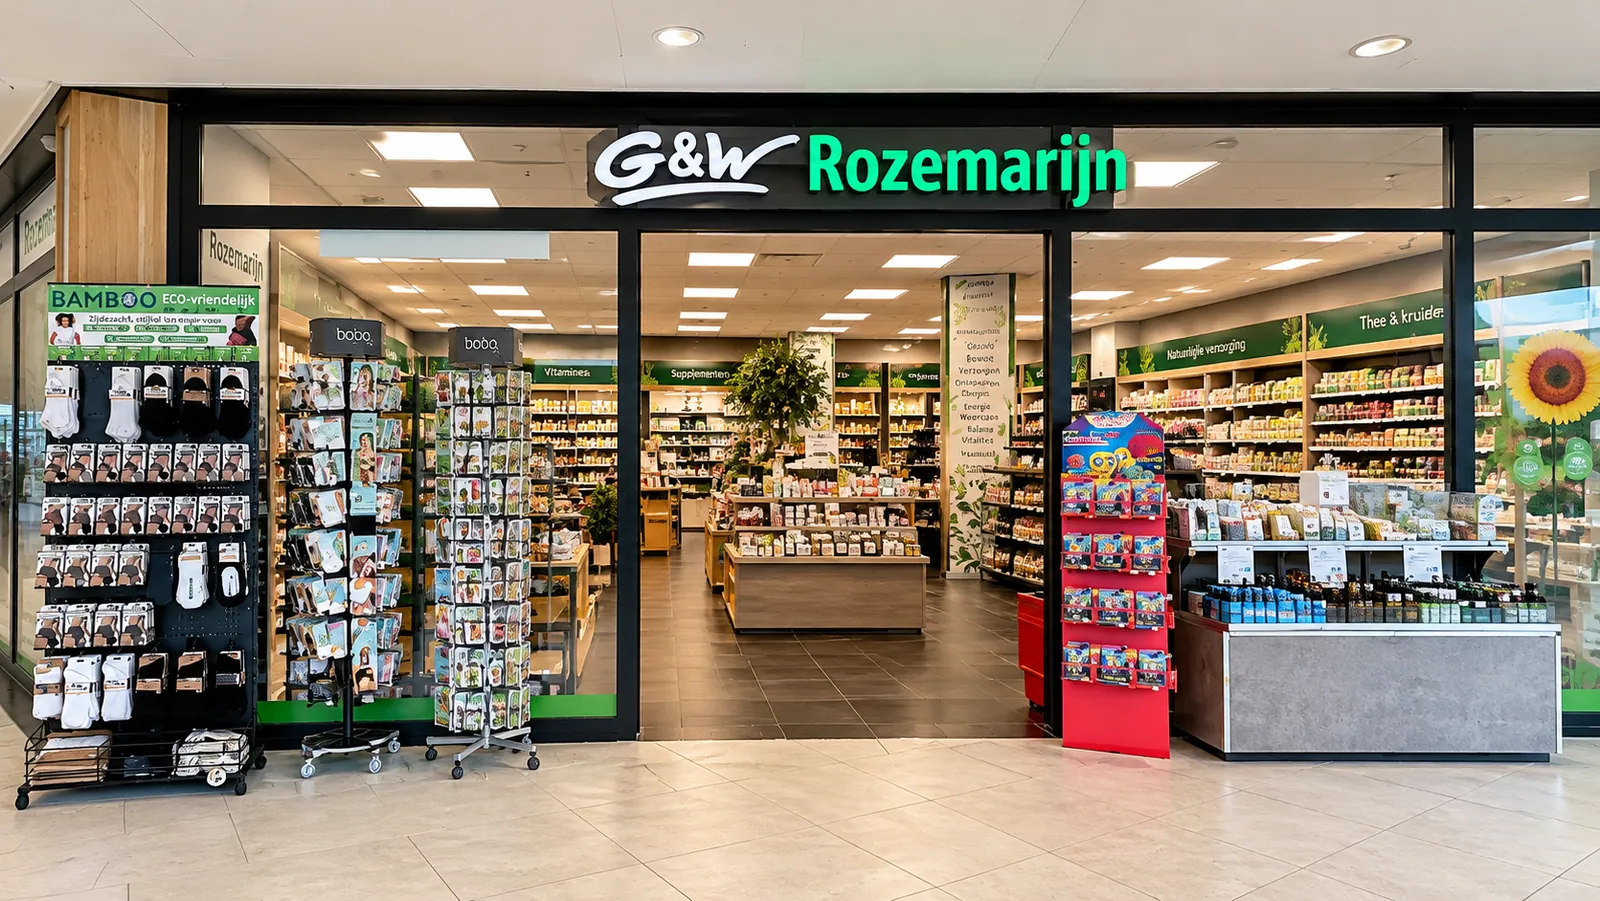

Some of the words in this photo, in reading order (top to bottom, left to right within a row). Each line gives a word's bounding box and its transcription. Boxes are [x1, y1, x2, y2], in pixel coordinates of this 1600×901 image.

[593, 130, 801, 190] G&W
[808, 133, 1127, 207] Rozemarijn
[209, 230, 264, 282] Rozemarijn
[52, 290, 157, 309] BAMBOO
[162, 293, 256, 309] ECO-vriendelijk
[1359, 314, 1387, 330] Thee
[1389, 311, 1399, 326] &
